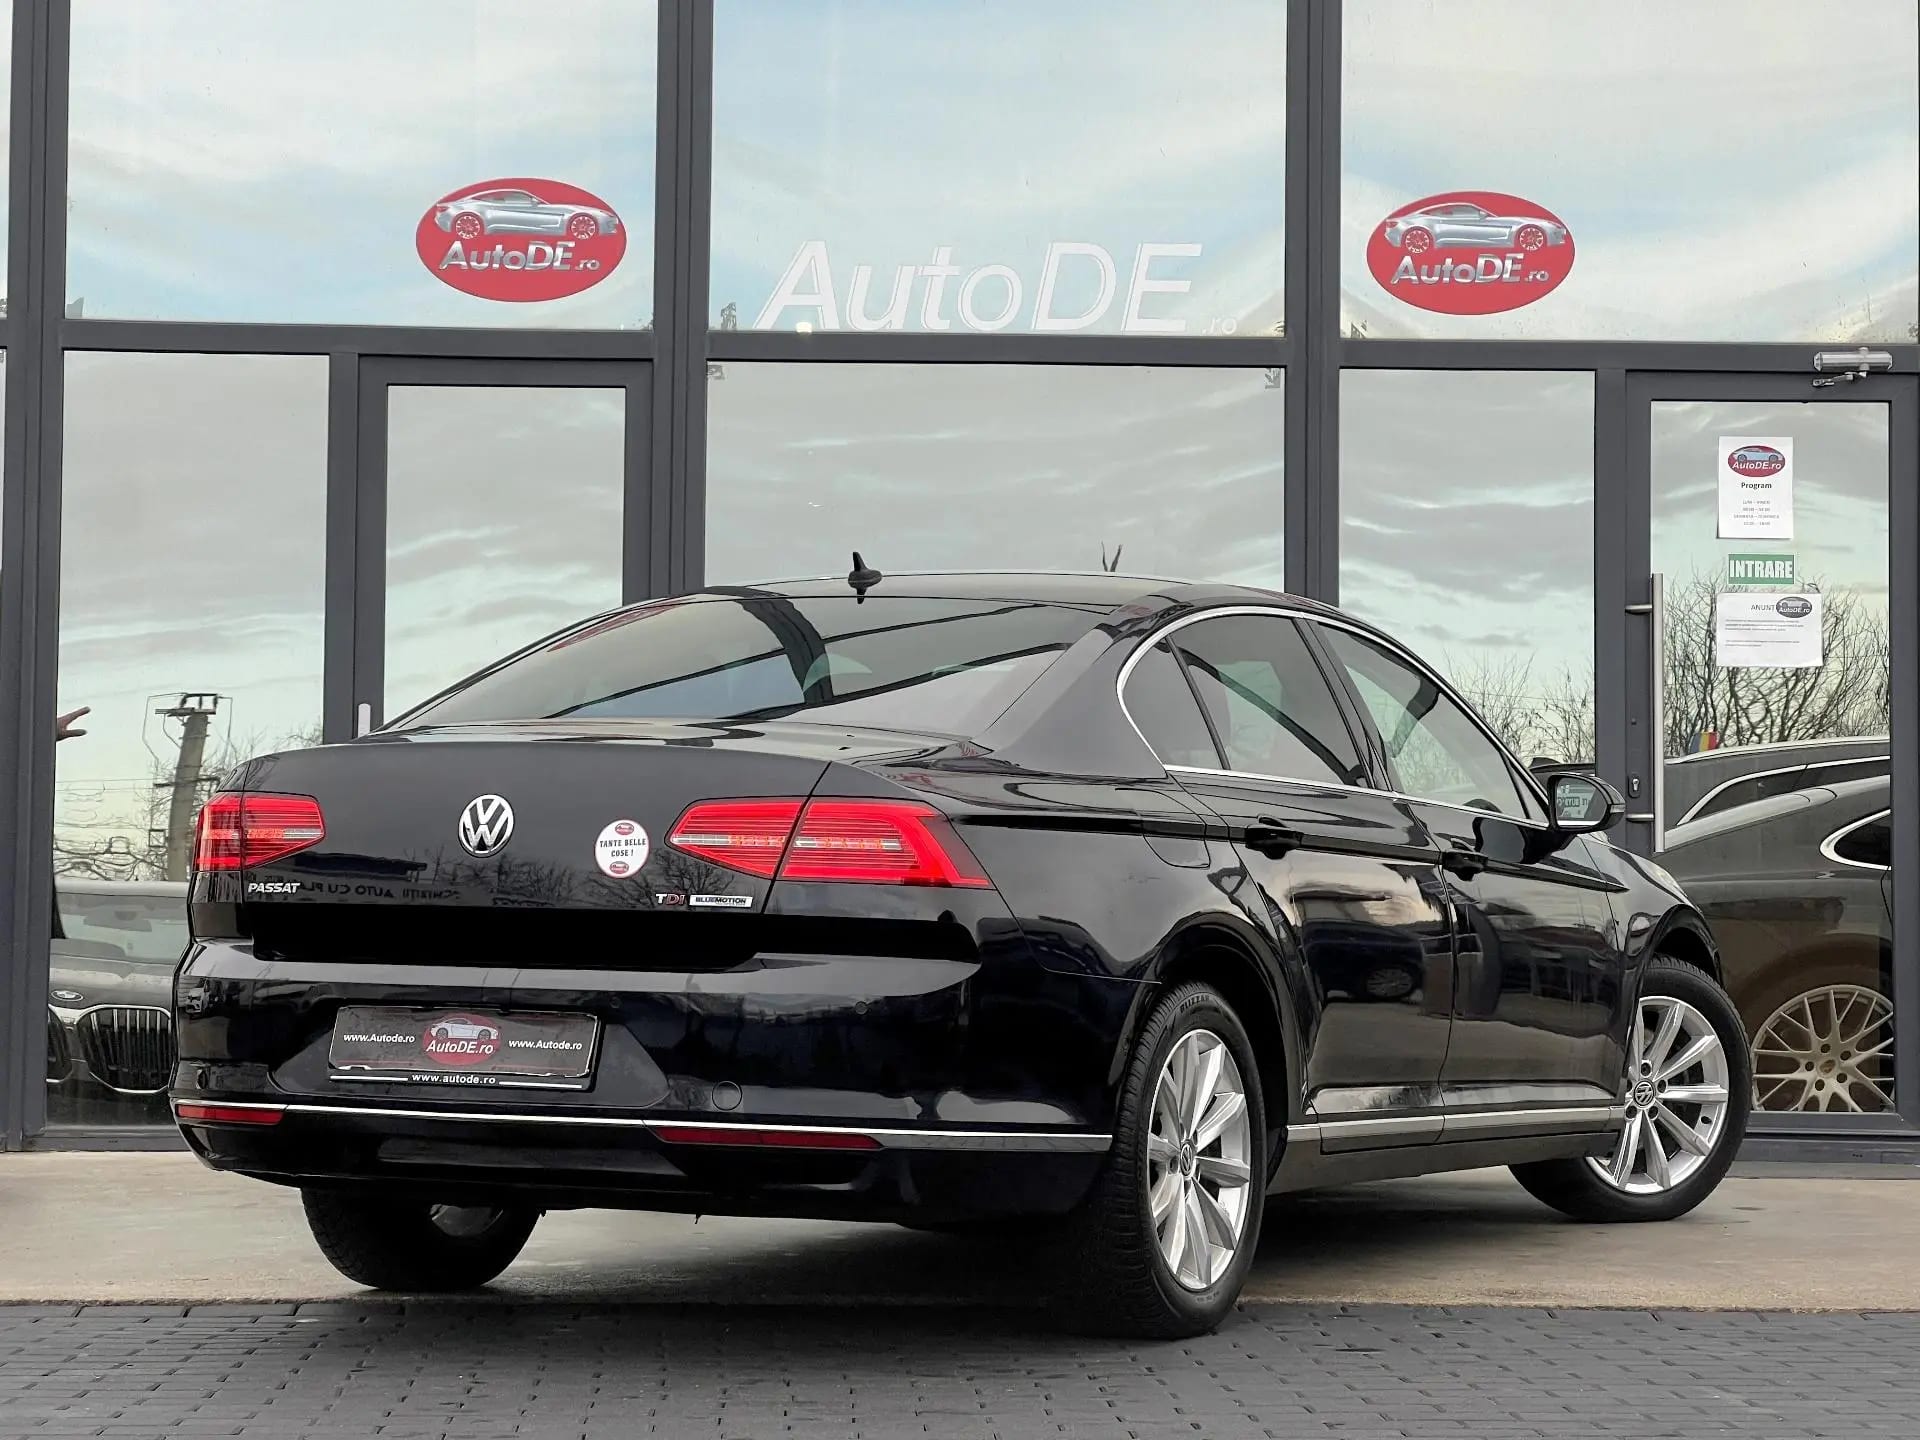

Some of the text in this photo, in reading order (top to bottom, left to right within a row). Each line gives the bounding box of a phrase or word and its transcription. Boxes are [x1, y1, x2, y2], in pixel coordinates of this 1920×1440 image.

[1732, 461, 1782, 471] AutoDE.ro
[1741, 482, 1772, 491] Program
[1729, 560, 1794, 578] INTRARE
[600, 838, 646, 848] TANTE BELLE
[611, 849, 629, 857] COSE
[248, 882, 301, 895] PASSAT
[655, 893, 686, 905] TDI
[695, 896, 746, 904] BLUEMOTION
[343, 1032, 583, 1055] www.Autode.ro AutoDE.ro www.Autode.ro
[411, 1073, 496, 1085] www.autode.ro
